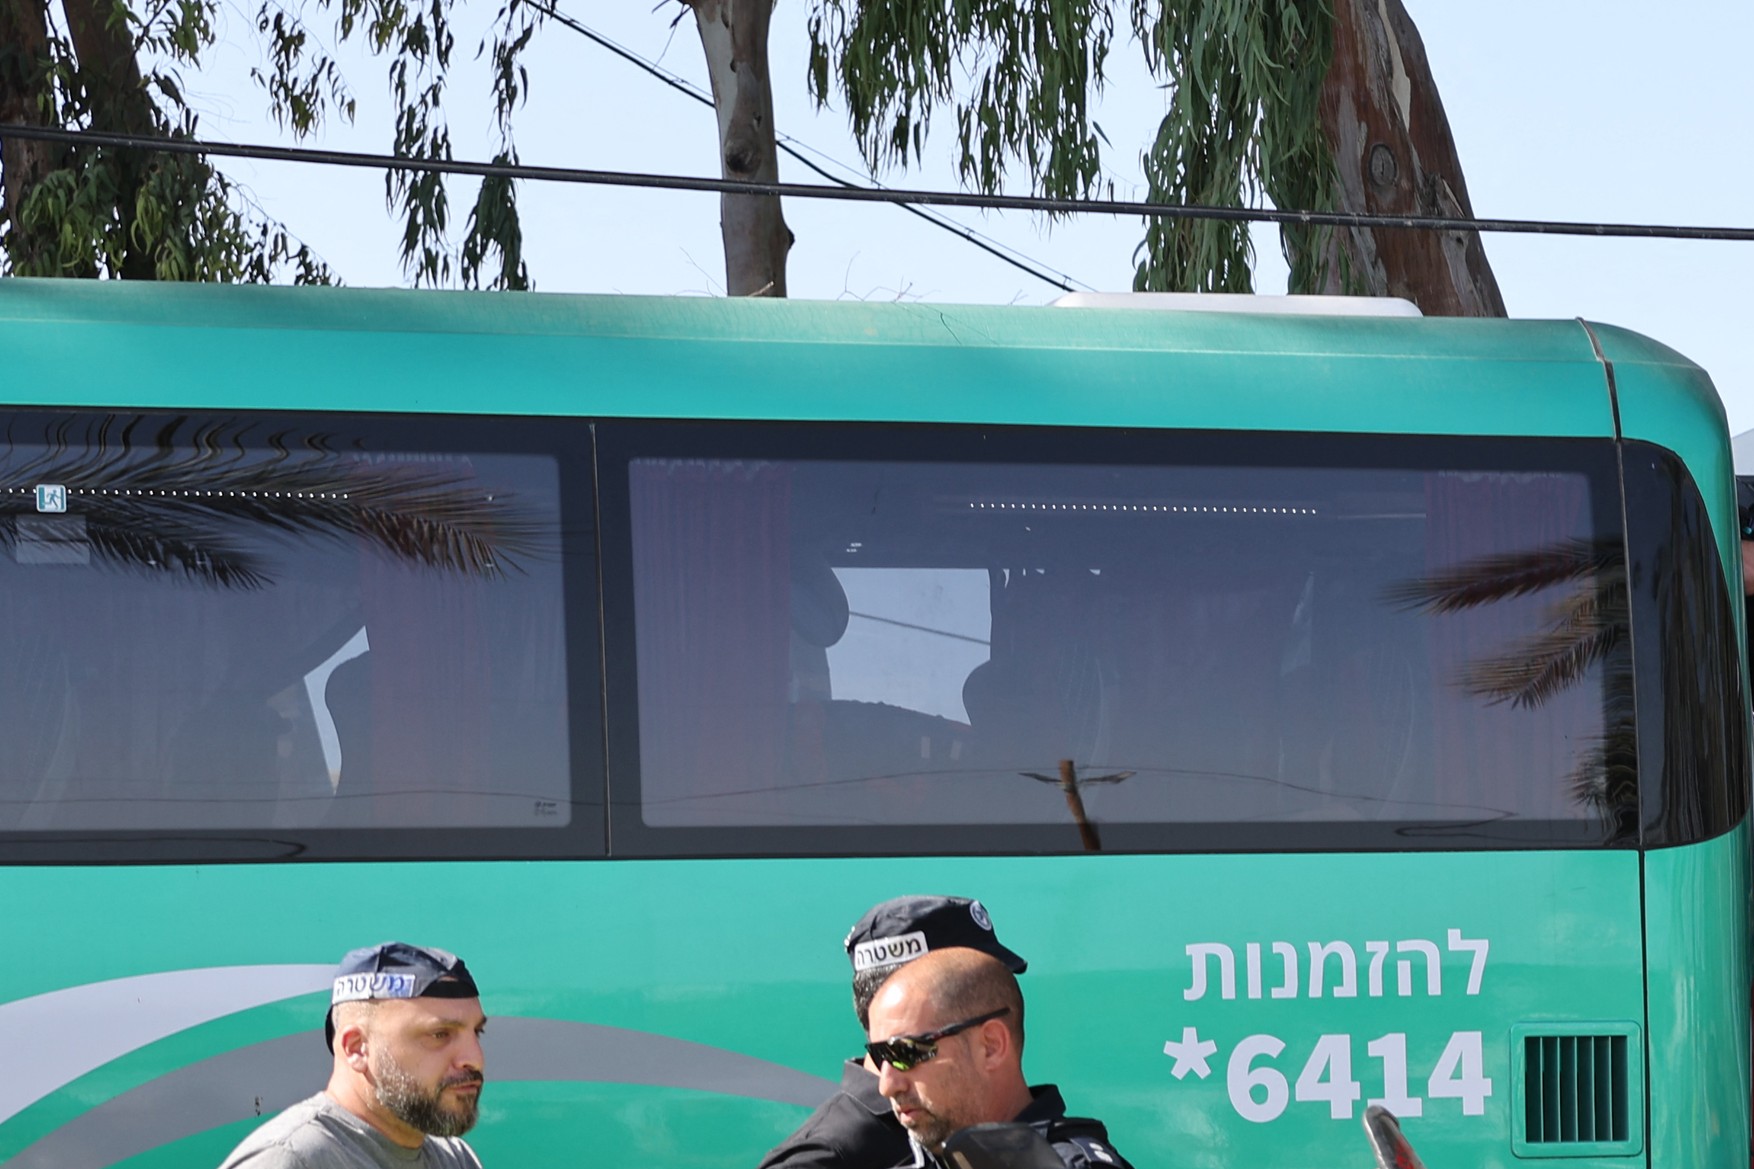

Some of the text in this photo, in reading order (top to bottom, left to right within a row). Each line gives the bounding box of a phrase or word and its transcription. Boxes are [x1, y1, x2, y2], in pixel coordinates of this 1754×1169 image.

[857, 937, 922, 965] משטרה
[1183, 928, 1490, 1002] להזמנות
[337, 975, 405, 997] משטרה
